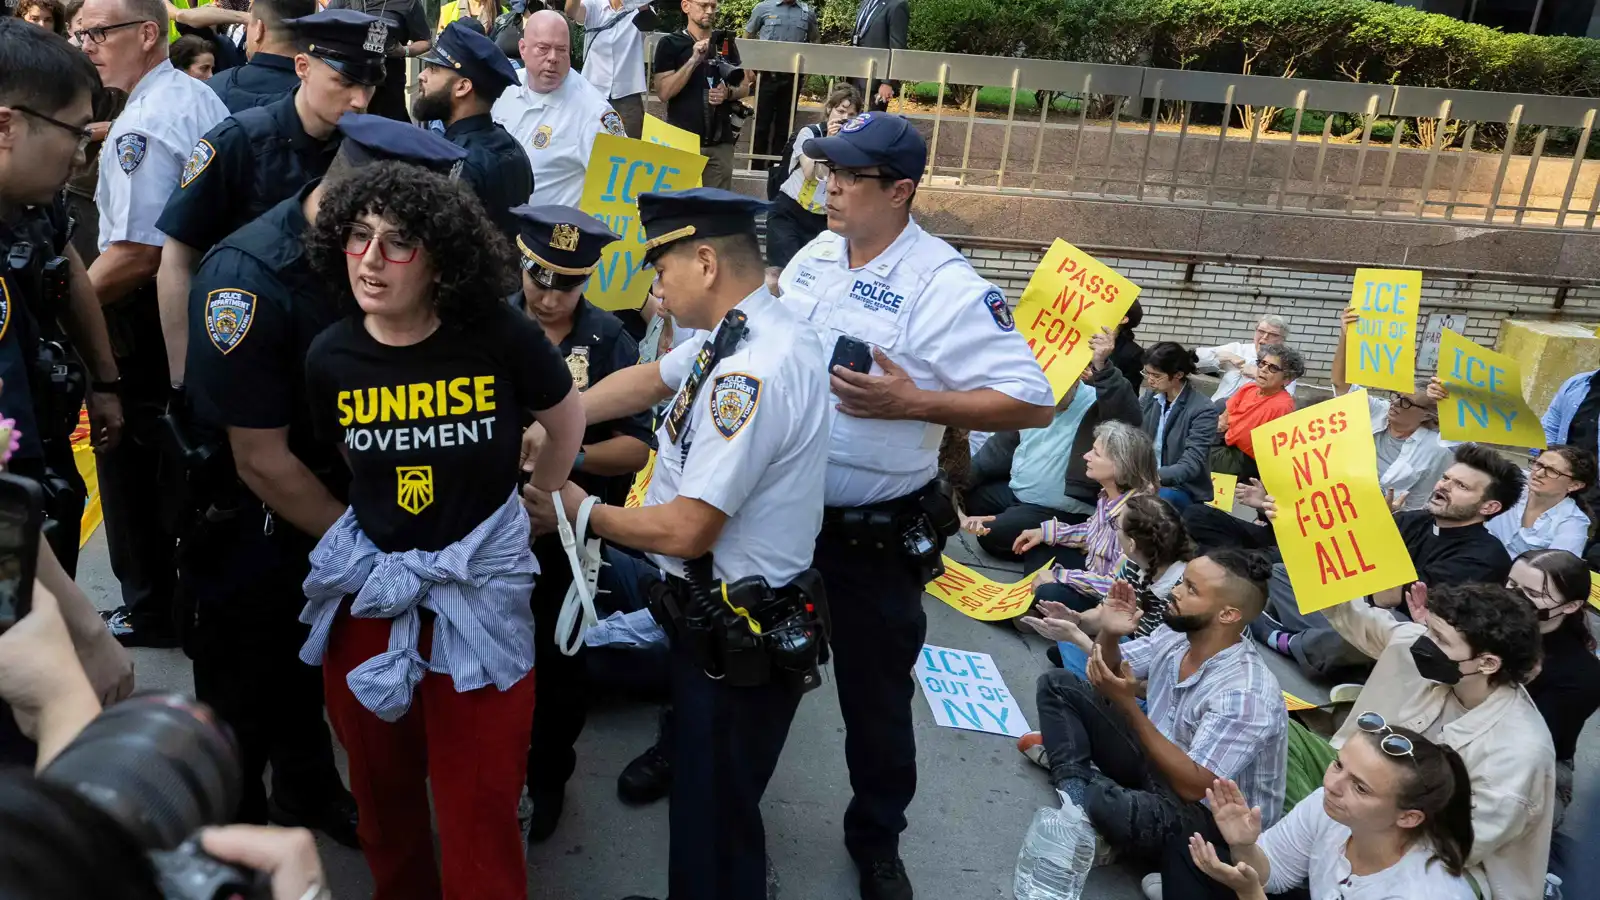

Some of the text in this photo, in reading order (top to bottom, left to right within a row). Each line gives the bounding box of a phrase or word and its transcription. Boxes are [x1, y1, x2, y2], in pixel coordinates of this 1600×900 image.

[600, 156, 680, 203] ICE
[219, 292, 242, 300] POLICE
[852, 280, 904, 308] POLICE
[873, 280, 891, 290] NYPD
[1056, 257, 1120, 304] PASS
[210, 299, 250, 310] DEPARTMENT
[849, 292, 898, 314] STRATEGIC RESPONSE
[1052, 285, 1096, 322] NY
[1360, 281, 1408, 315] ICE
[239, 314, 251, 332] YORK
[1031, 308, 1081, 355] FOR
[1357, 317, 1408, 340] OUT OF
[1438, 317, 1455, 329] NO
[1360, 341, 1402, 376] NY
[1450, 347, 1506, 395] ICE
[715, 382, 756, 395] DEPARTMENT
[724, 376, 747, 384] POLICE
[337, 375, 496, 427] SUNRISE
[742, 400, 754, 418] YORK
[1458, 399, 1518, 431] NY
[344, 416, 496, 451] MOVEMENT
[1271, 411, 1347, 456] PASS
[1292, 444, 1331, 490] NY
[1295, 483, 1358, 537] FOR
[1315, 530, 1376, 585] ALL
[932, 565, 976, 596] NY
[958, 584, 1004, 611] OUT OF
[923, 647, 993, 680] ICE
[925, 676, 1009, 702] OUT OF
[941, 698, 1009, 734] NY
